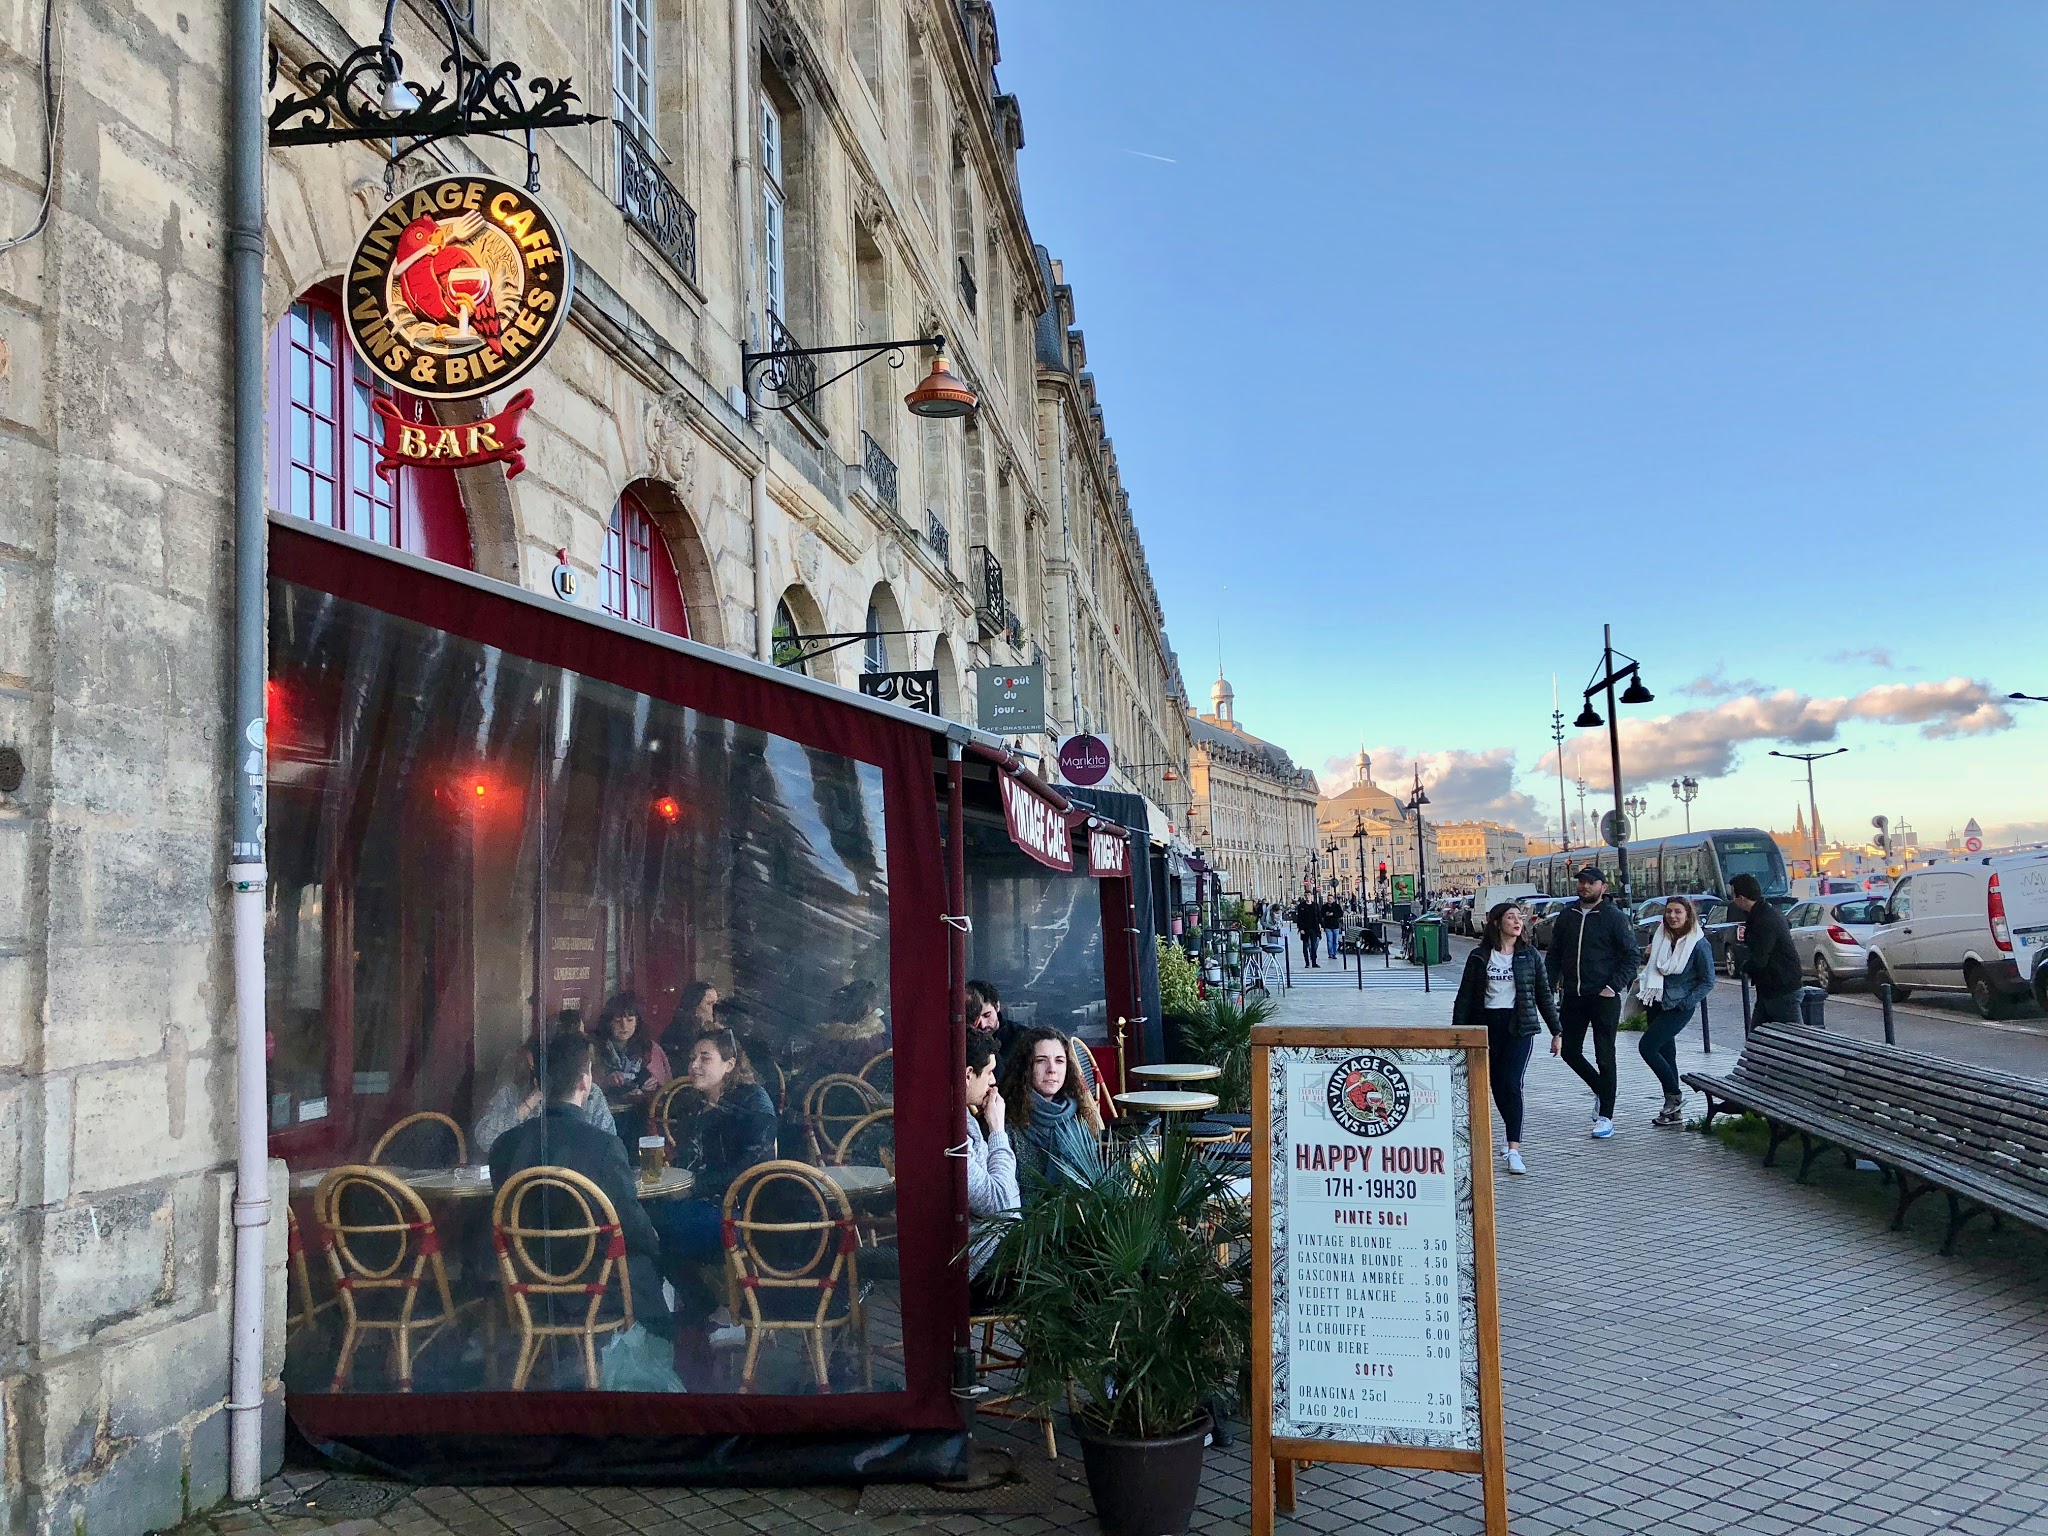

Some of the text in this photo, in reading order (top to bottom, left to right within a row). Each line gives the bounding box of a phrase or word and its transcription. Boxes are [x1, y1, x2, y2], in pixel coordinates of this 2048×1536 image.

[352, 182, 563, 280] VINTAGE CAFÉ
[352, 297, 412, 372] VINS
[410, 355, 438, 385] &
[397, 422, 504, 460] BAR
[560, 572, 576, 594] 19
[1003, 691, 1017, 700] du
[993, 705, 1015, 717] jour
[1061, 751, 1106, 766] Marikita
[1003, 776, 1045, 853] VINTAGE
[1329, 1057, 1409, 1098] VINTAGE CAFÉ
[1331, 1104, 1360, 1133] VINS
[1296, 1143, 1446, 1175] HAPPY HOUR
[1334, 1209, 1408, 1226] PINTE 50cl
[1298, 1233, 1448, 1251] VINTAGE BLONDE 3.50
[1298, 1251, 1448, 1269] GASCONHA BLONDE 4.50
[1298, 1268, 1449, 1287] GASCONHA AMBRÉE 5.00
[1298, 1286, 1449, 1305] VEDETT BLANCHE 5.00
[1298, 1303, 1450, 1323] VEDETT IPA 5.50
[1298, 1321, 1450, 1341] LA CHOUFFE 6.00
[1299, 1339, 1331, 1352] PICON
[1426, 1345, 1451, 1359] 5.00
[1355, 1362, 1394, 1377] SOFTS
[1299, 1385, 1452, 1407] ORANGINA 25cl 2.50
[1299, 1403, 1453, 1425] PAGO 20cl 2.50
